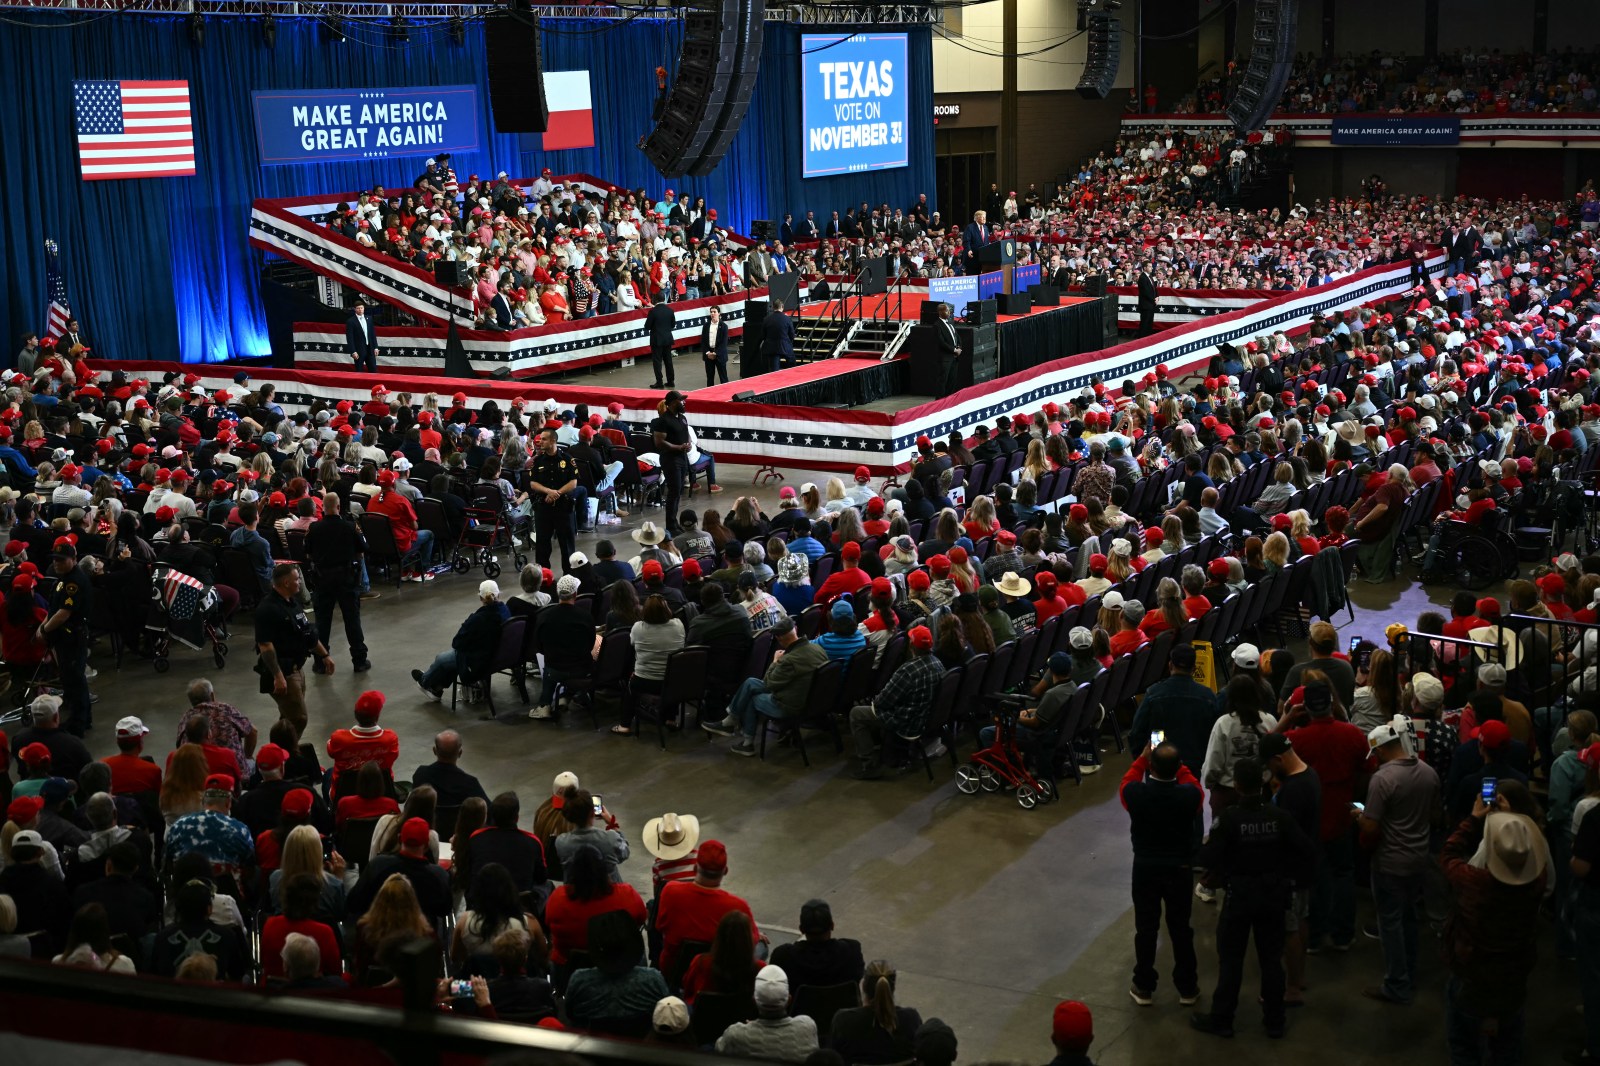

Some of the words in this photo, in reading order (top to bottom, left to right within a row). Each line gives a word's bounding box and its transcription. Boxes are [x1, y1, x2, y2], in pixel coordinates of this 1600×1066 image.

[819, 60, 894, 100] TEXAS
[292, 104, 353, 127] MAKE
[360, 101, 448, 125] AMERICA
[834, 102, 863, 122] VOTE
[864, 101, 881, 120] ON
[934, 104, 960, 115] ROOMS
[301, 127, 368, 151] GREAT
[376, 124, 444, 147] AGAIN!
[810, 123, 888, 152] NOVEMBER
[890, 121, 903, 144] 3!
[1240, 821, 1278, 835] POLICE
